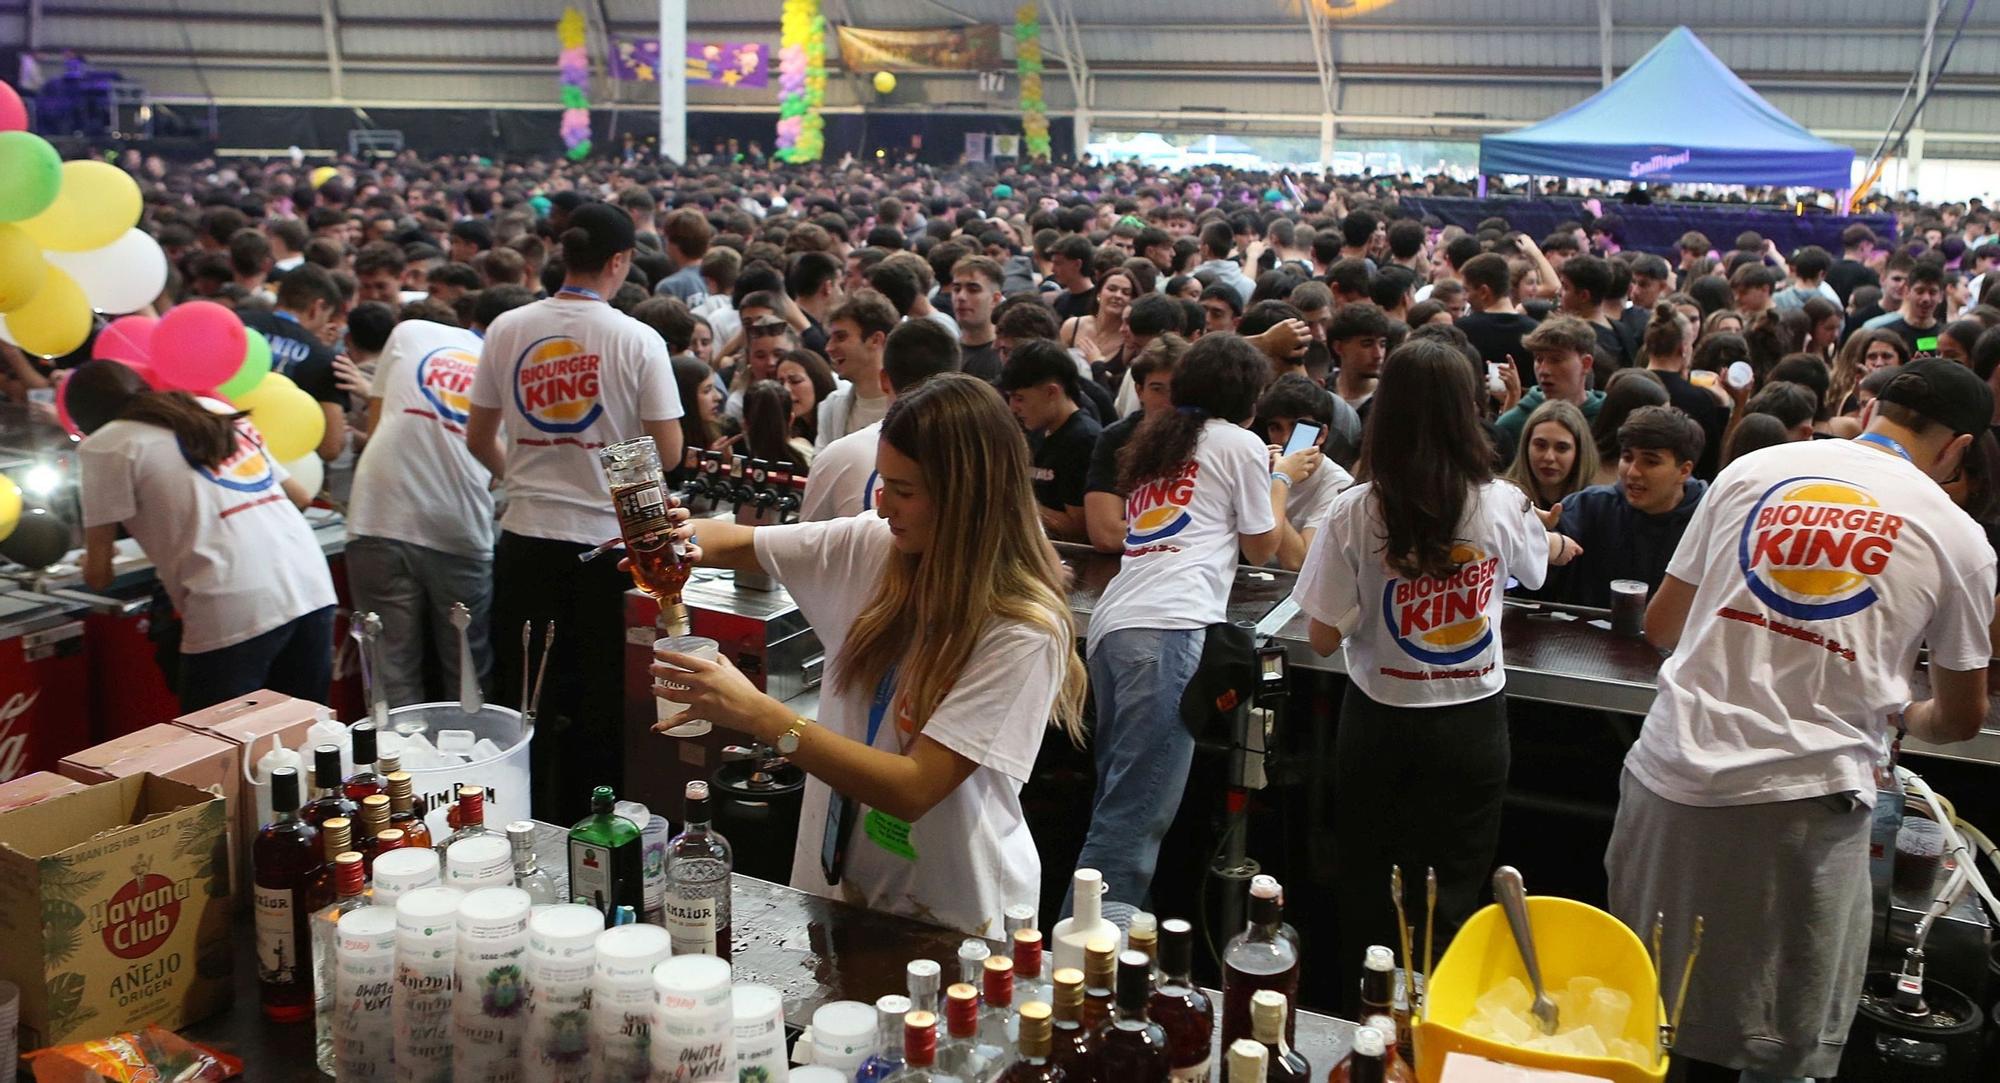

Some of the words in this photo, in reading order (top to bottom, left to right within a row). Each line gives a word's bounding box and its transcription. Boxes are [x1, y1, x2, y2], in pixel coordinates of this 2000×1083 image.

[520, 354, 600, 386] BIOURGER
[525, 372, 599, 412] KING
[1128, 478, 1195, 519] KING
[1756, 504, 1904, 540] BIOURGER
[1750, 528, 1894, 576] KING
[1400, 577, 1494, 638] KING
[89, 877, 193, 934] Havana
[112, 908, 170, 950] Club
[110, 953, 181, 998] AÑEJO
[119, 977, 173, 1008] ORIGEN
